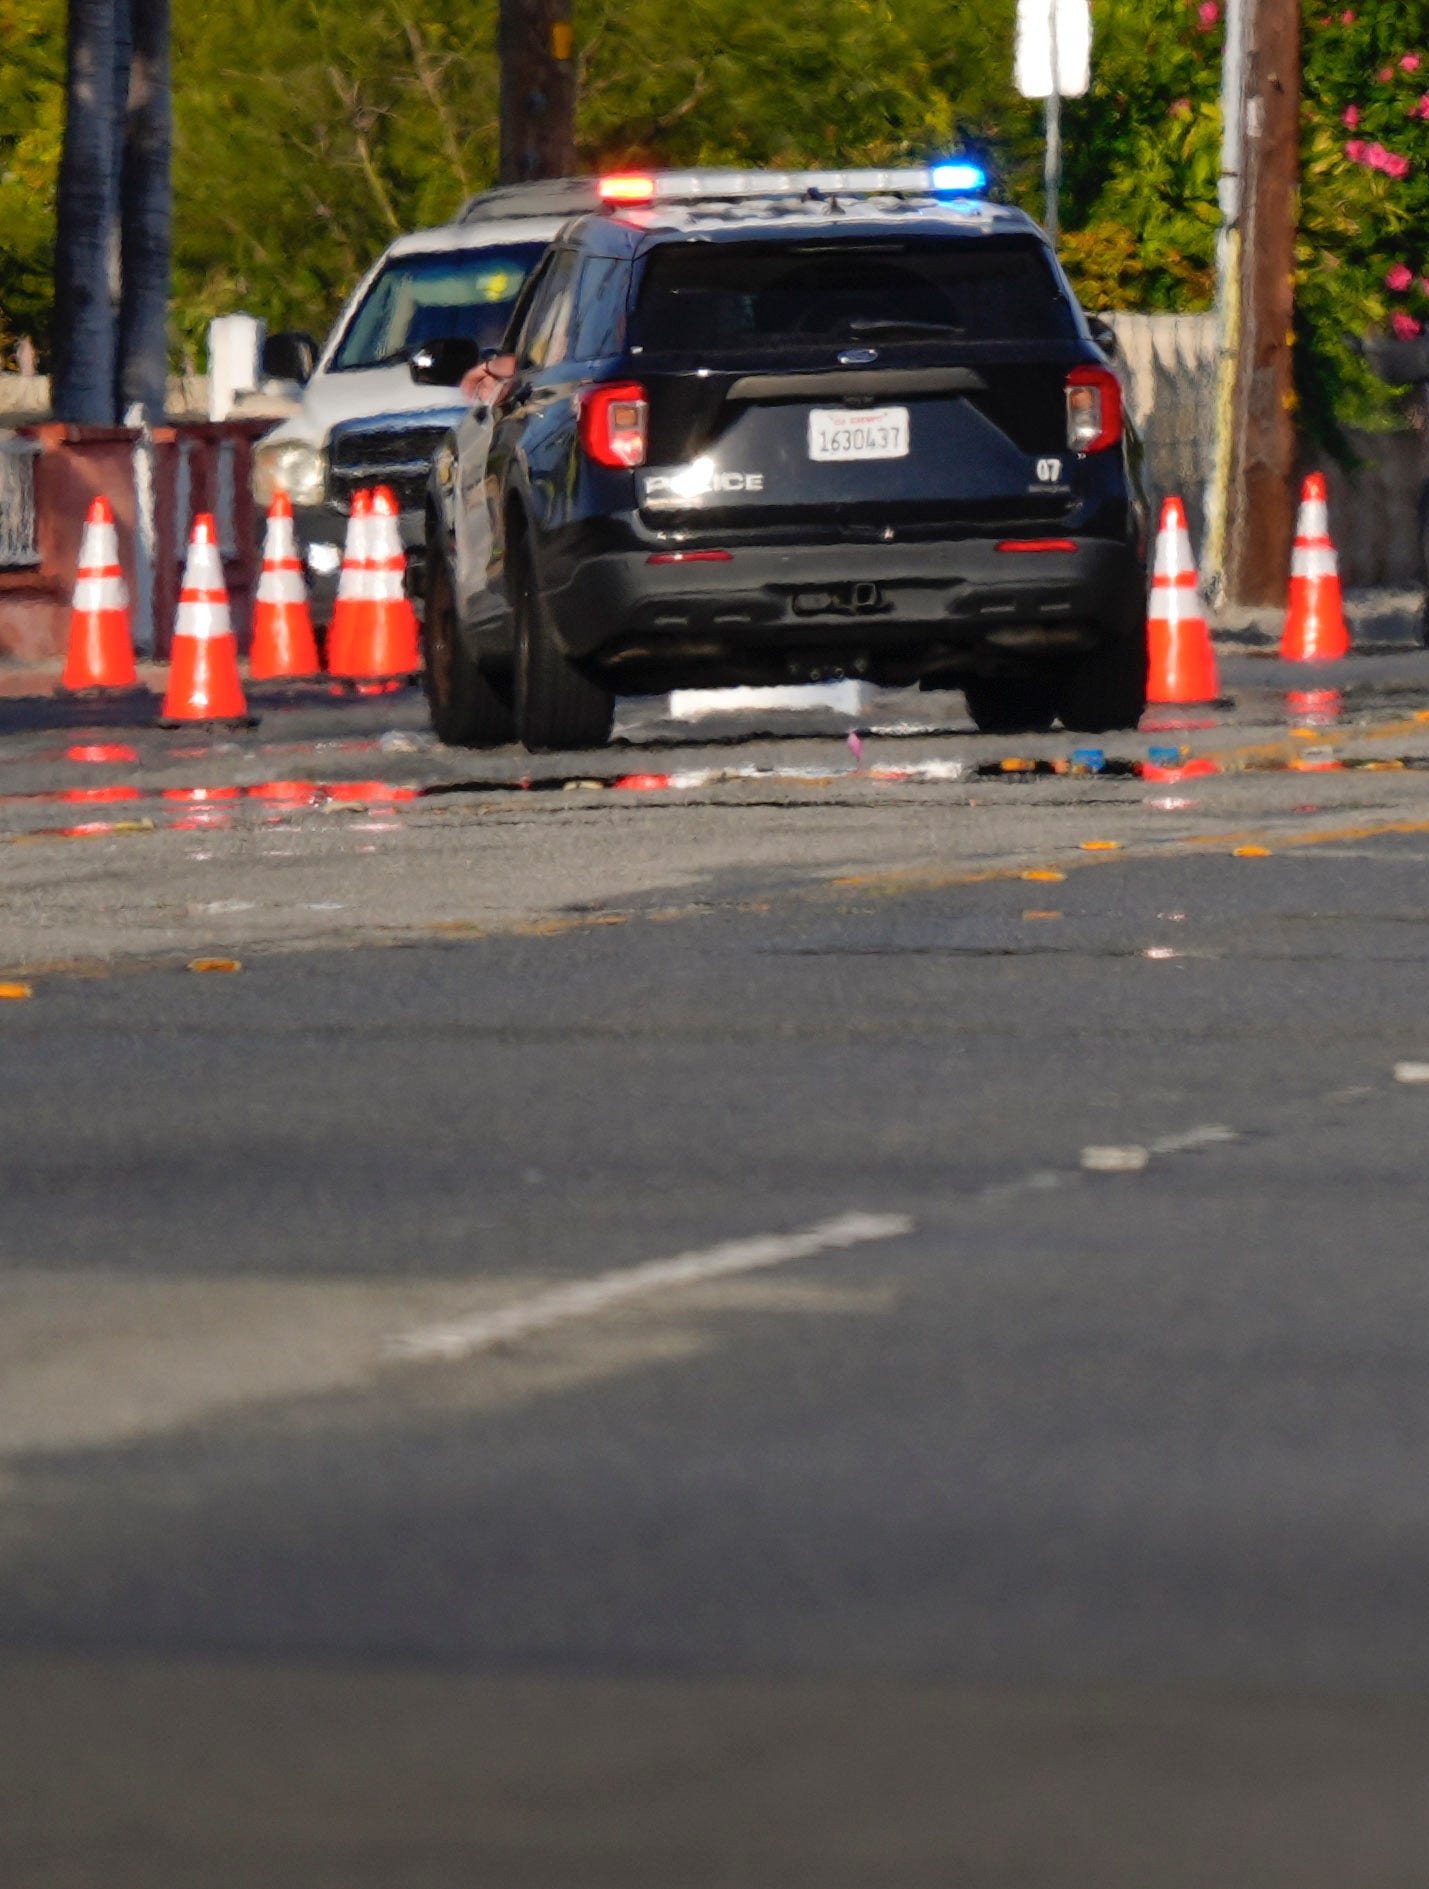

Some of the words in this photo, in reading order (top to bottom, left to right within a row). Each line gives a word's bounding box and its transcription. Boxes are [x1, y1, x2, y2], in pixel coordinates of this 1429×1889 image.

[820, 427, 900, 452] 1630437
[1036, 458, 1062, 482] 07
[645, 472, 764, 494] PICE
